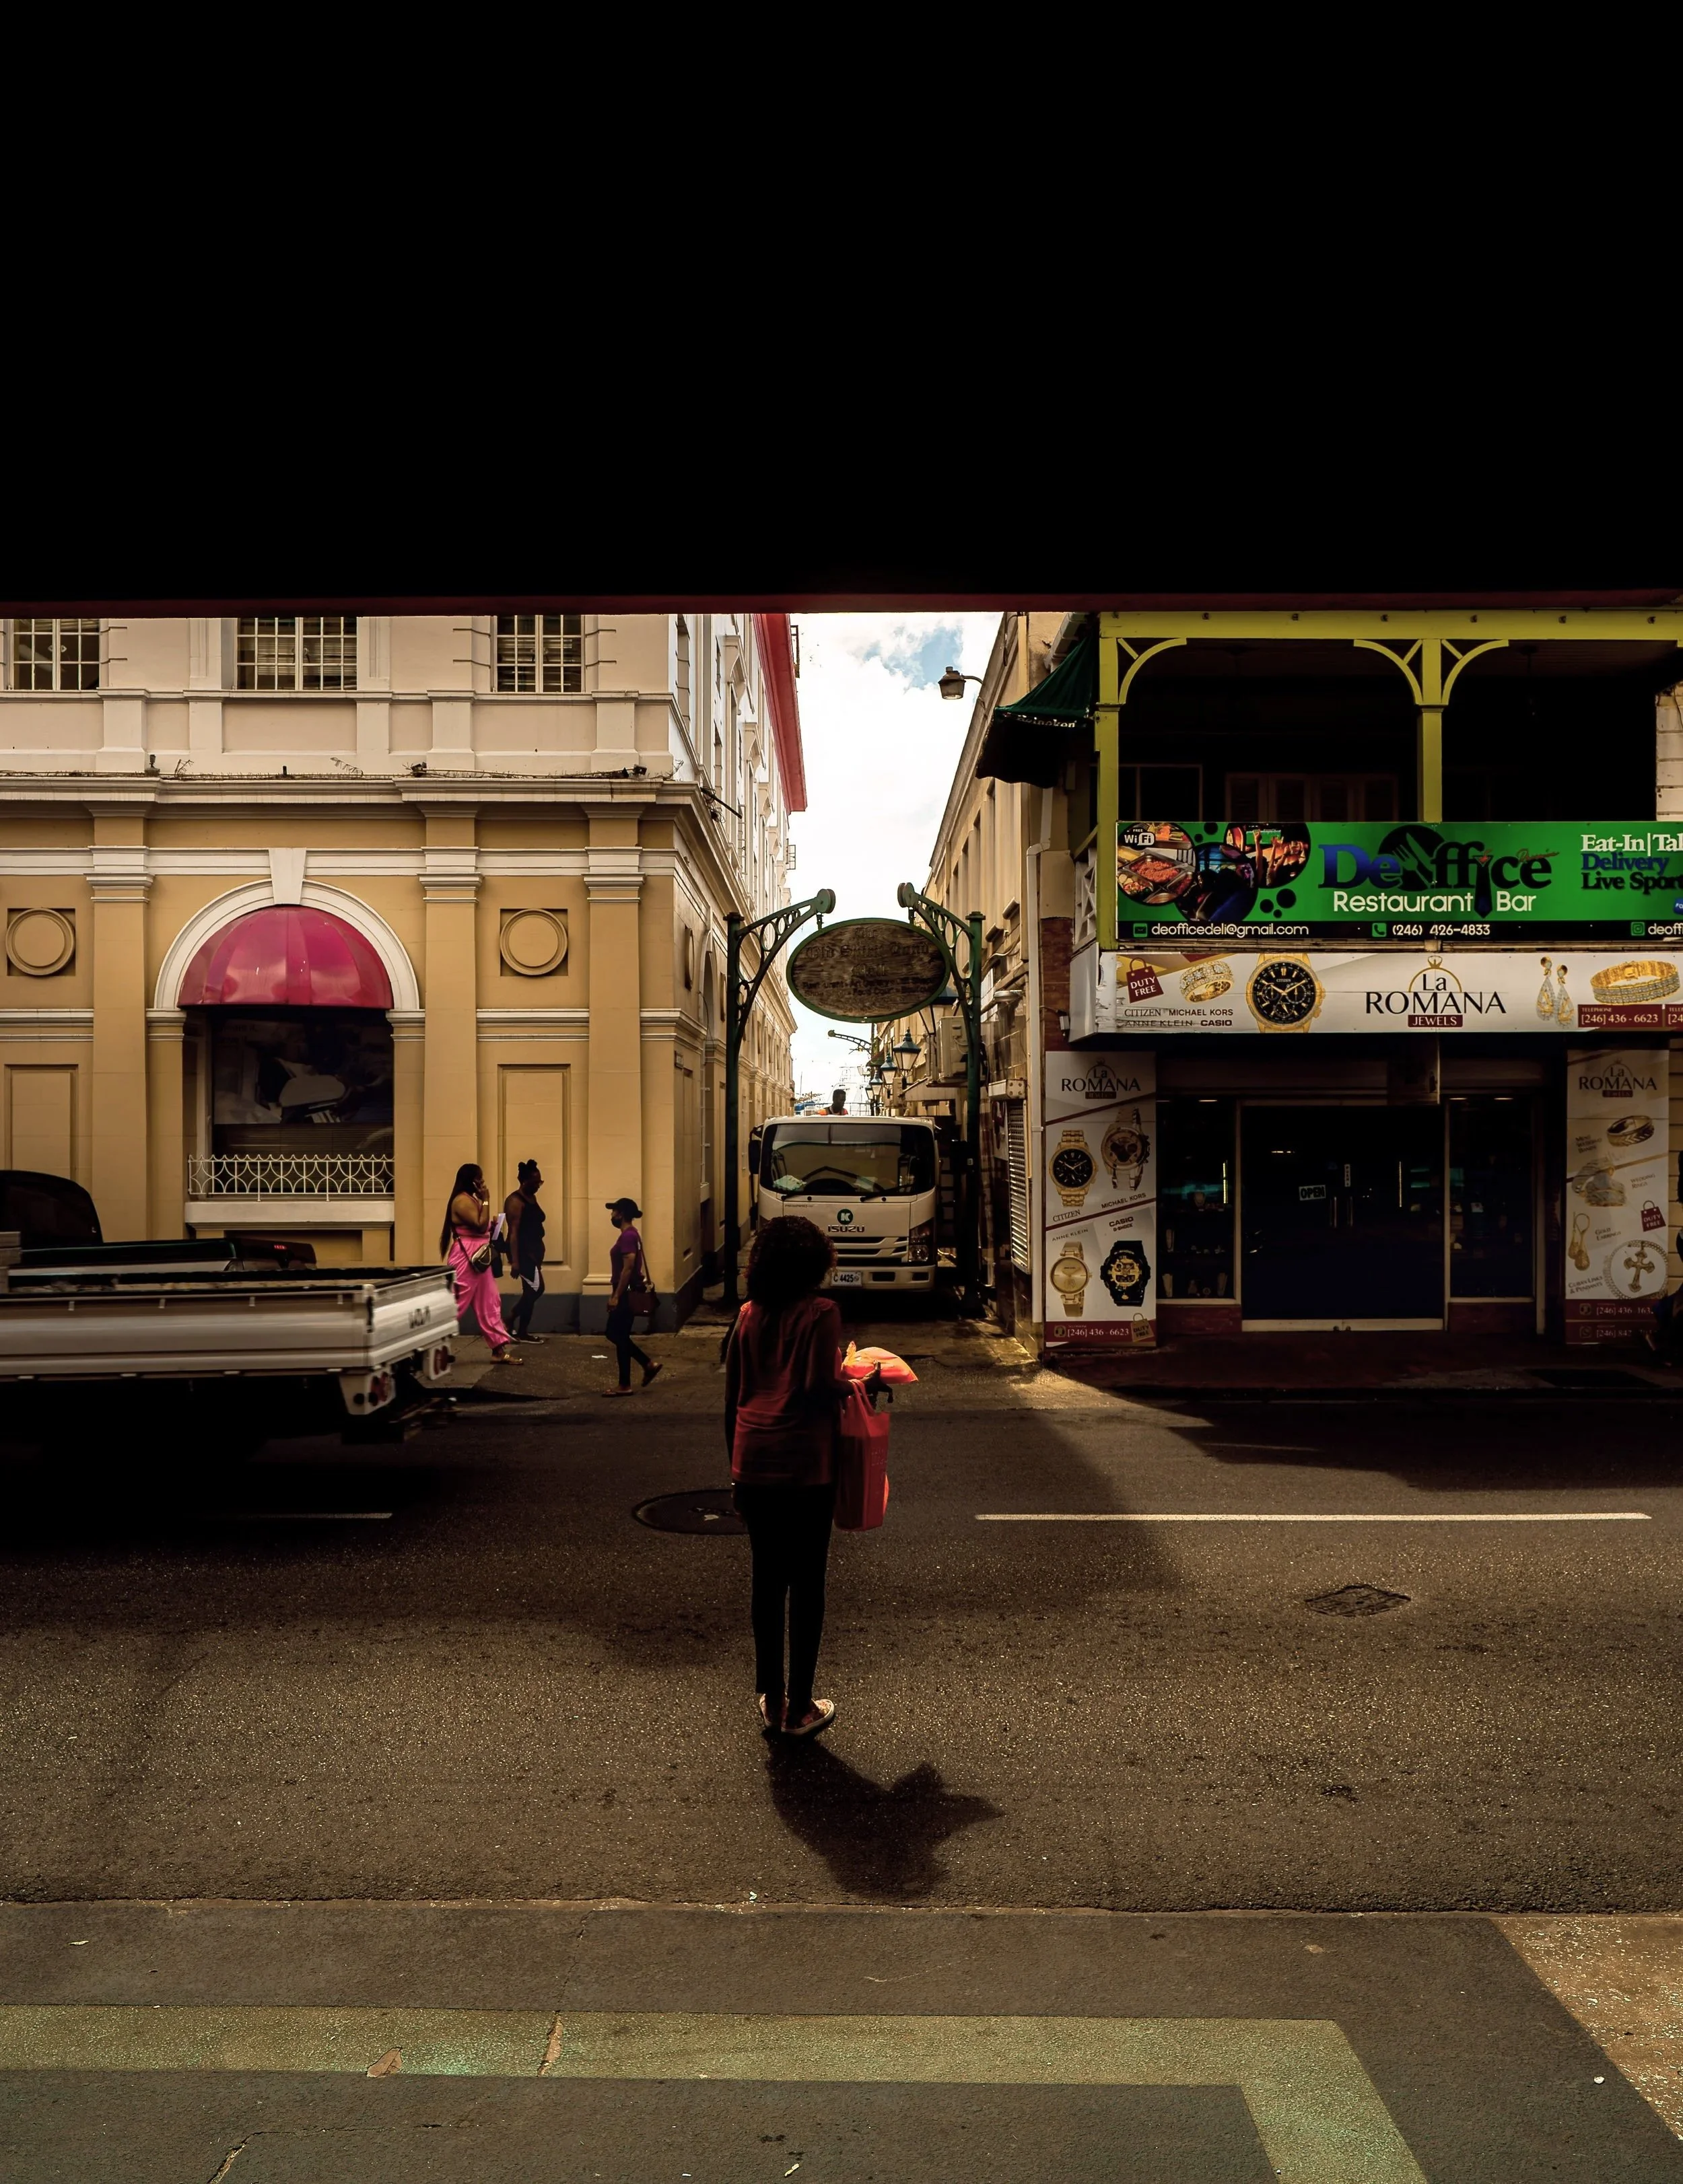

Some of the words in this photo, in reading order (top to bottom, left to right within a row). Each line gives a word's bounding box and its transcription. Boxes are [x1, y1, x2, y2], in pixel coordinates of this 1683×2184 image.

[1581, 852, 1670, 875] Delivery
[1581, 871, 1624, 889] Live
[1334, 891, 1474, 912] Restaurant
[1496, 891, 1537, 912] Bar
[1151, 923, 1309, 938] deofficedeli@gmail.com
[1392, 924, 1422, 936] (246)
[1429, 924, 1490, 936] 426-4833
[1130, 976, 1156, 989] DUTY
[1422, 974, 1447, 991] La
[1135, 985, 1157, 997] FREE
[1366, 991, 1507, 1014] ROMANA
[1124, 1009, 1161, 1017] CITIZEN
[1581, 1014, 1606, 1024] [246]
[1608, 1014, 1626, 1023] 436
[1634, 1014, 1658, 1023] 6623
[1412, 1016, 1457, 1026] JEWELS
[1610, 1067, 1624, 1077] La
[1062, 1078, 1141, 1092] ROMANA
[1579, 1076, 1657, 1090] ROMANA
[1101, 1198, 1128, 1209] MICHAEL
[1130, 1193, 1146, 1201] KORS
[841, 1212, 851, 1222] K
[1052, 1209, 1080, 1222] CITIZEN
[1109, 1216, 1134, 1227] CASIO
[1643, 1213, 1661, 1222] DUTY
[827, 1225, 865, 1233] ISUZU
[1052, 1232, 1069, 1242] ANNE
[1070, 1228, 1089, 1236] KLEIN
[839, 1274, 854, 1282] 4425
[1068, 1329, 1087, 1338] [246]
